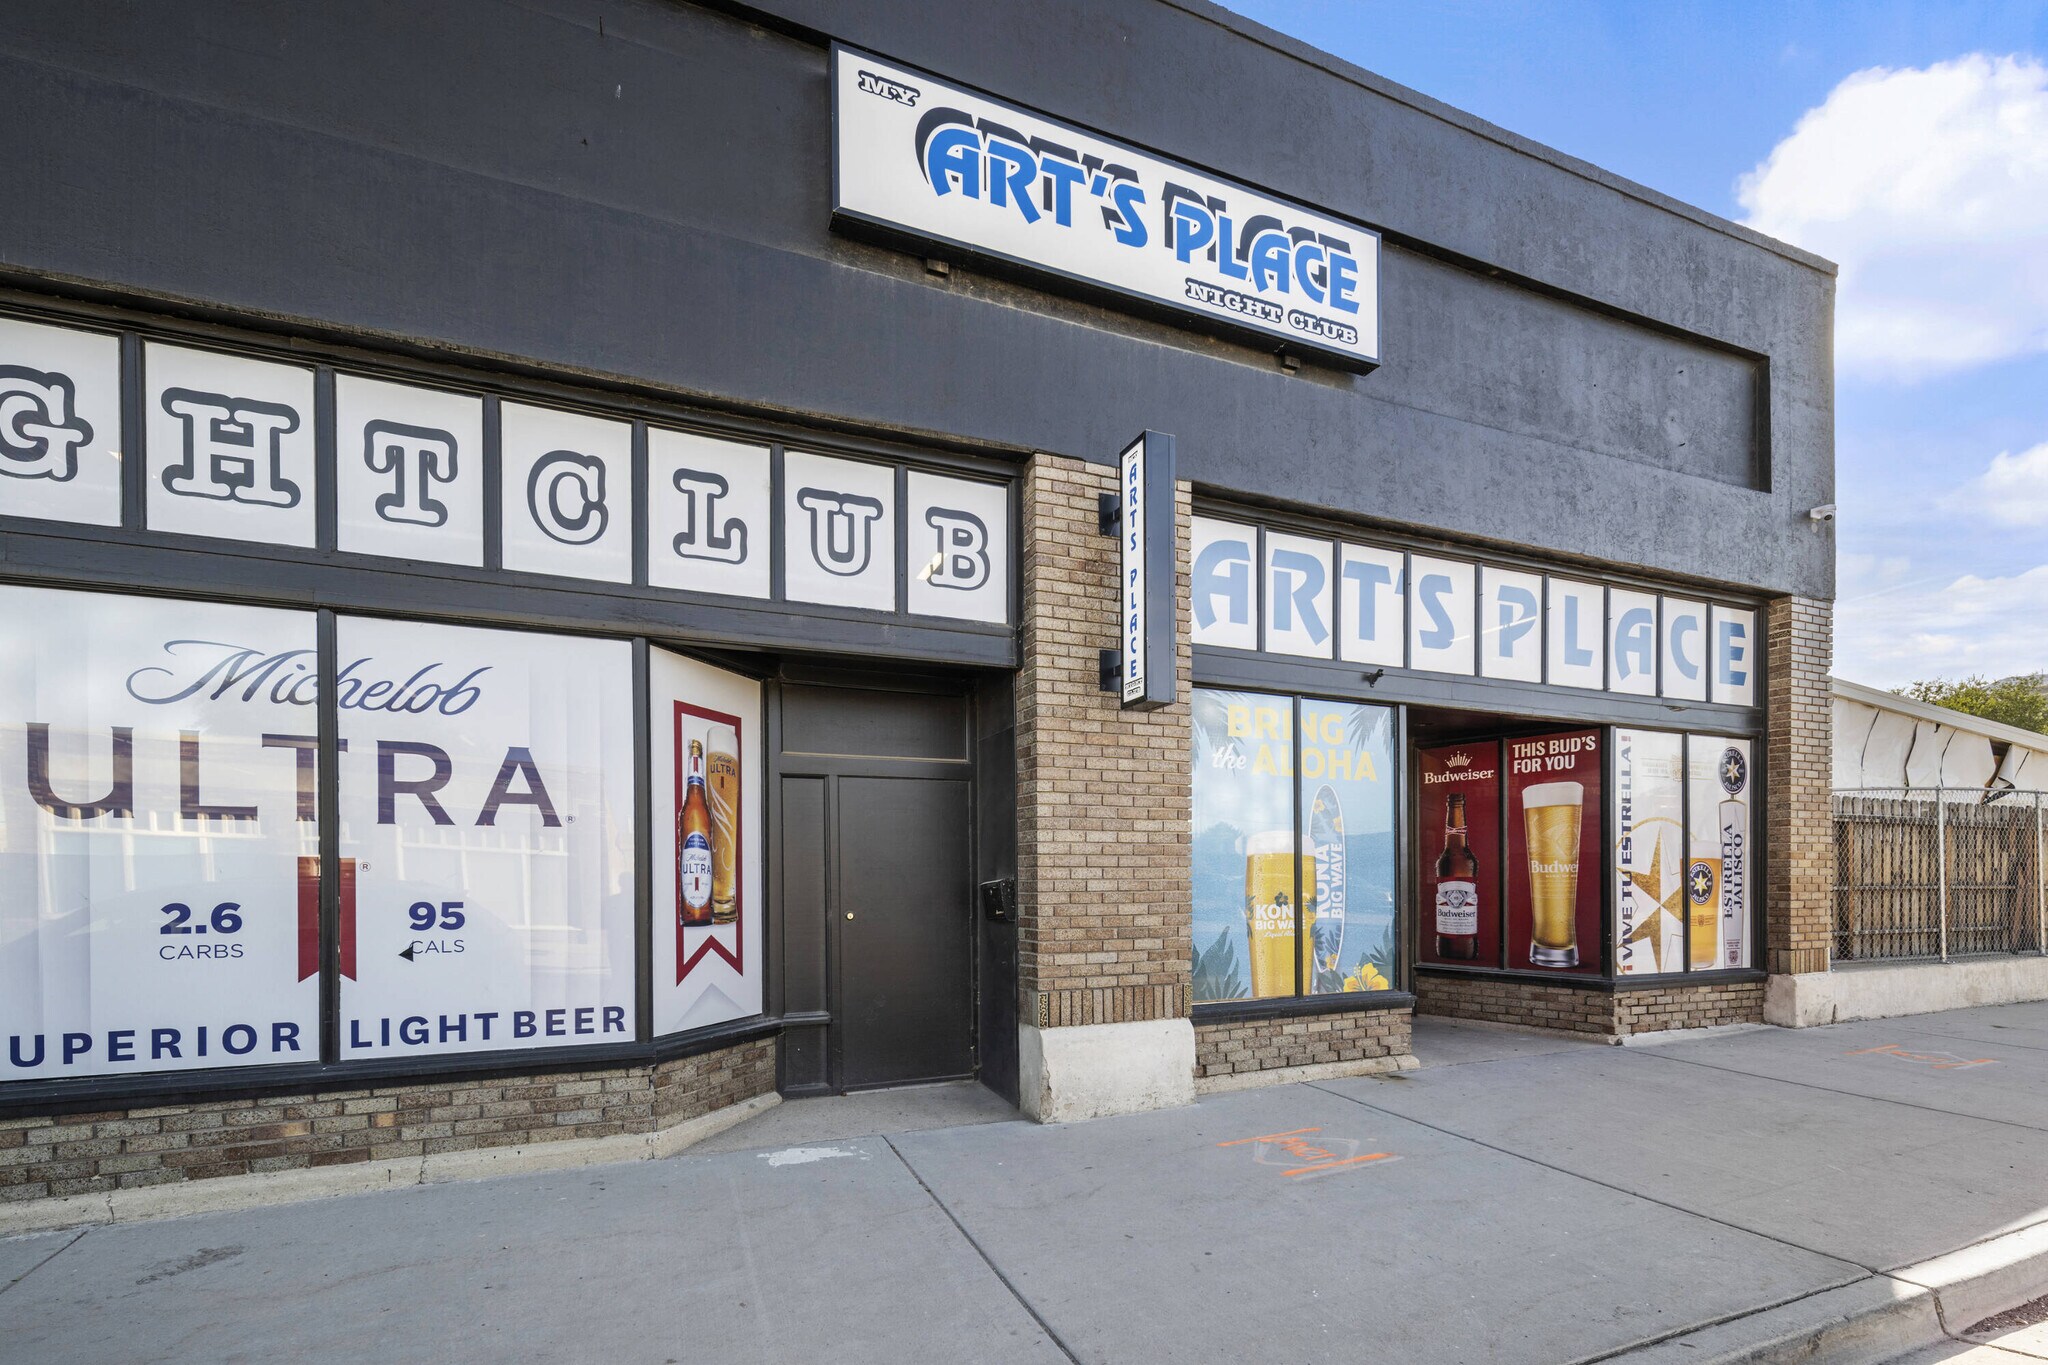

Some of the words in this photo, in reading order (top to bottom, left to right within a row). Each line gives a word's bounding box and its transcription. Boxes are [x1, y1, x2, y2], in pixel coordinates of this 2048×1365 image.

[858, 70, 920, 107] MY
[916, 109, 1148, 249] ART'S
[1163, 182, 1361, 315] PLACE
[1185, 278, 1283, 323] NIGHT
[1287, 308, 1359, 344] CLUB
[527, 449, 991, 591] CLUB
[1129, 462, 1138, 552] ARTS
[1129, 568, 1138, 678] PLACE
[1497, 584, 1748, 687] PLACE
[126, 639, 494, 716] Michelob
[1228, 703, 1345, 746] BRING
[1211, 743, 1247, 770] the
[1252, 743, 1378, 782] ALOHA
[1513, 742, 1547, 758] THIS
[1549, 735, 1597, 755] BUD'S
[1513, 759, 1542, 774] FOR
[1544, 754, 1576, 771] YOU
[25, 721, 563, 828] ULTRA
[709, 763, 737, 778] ULTRA
[1424, 768, 1494, 784] Budweiser
[682, 862, 712, 875] ULTRA
[1316, 843, 1331, 919] KONA
[1330, 843, 1343, 888] WAVE
[1723, 823, 1733, 919] ESTRELLA
[1733, 833, 1743, 909] JALISCO
[1330, 891, 1343, 919] BIG
[1621, 870, 1633, 902] TU
[160, 902, 243, 935] 2.6
[408, 901, 466, 931] 95
[1255, 903, 1305, 920] KON
[1255, 919, 1275, 930] BIG
[1276, 919, 1306, 930] WAE
[1437, 908, 1476, 918] Budweiser
[159, 943, 244, 960] CARBS
[410, 939, 465, 954] CALS
[350, 1011, 499, 1049] LIGHT
[513, 1006, 626, 1038] BEER
